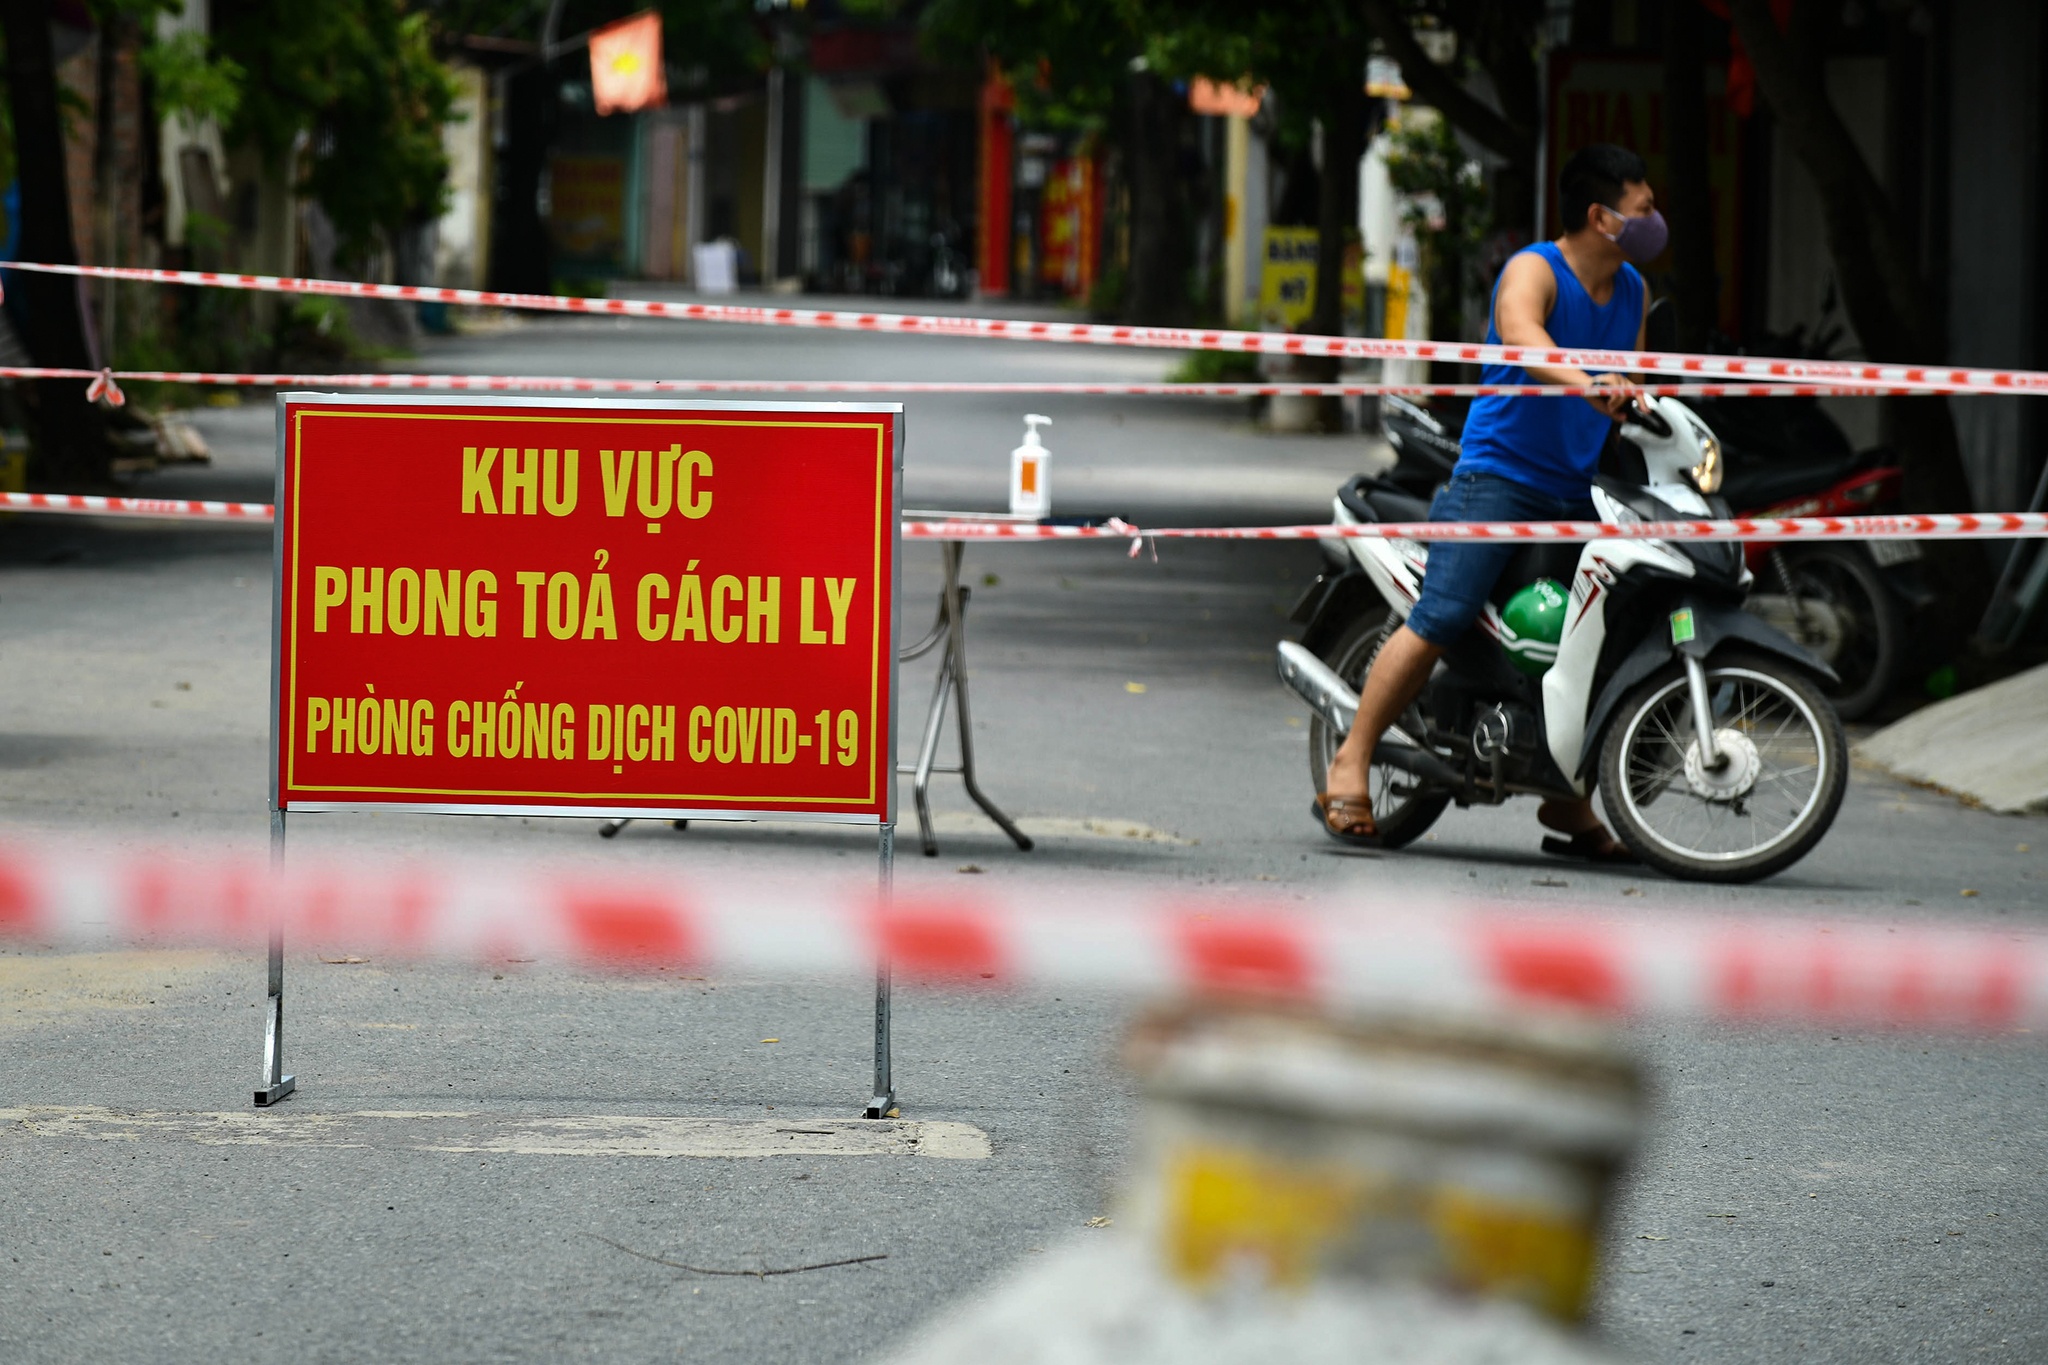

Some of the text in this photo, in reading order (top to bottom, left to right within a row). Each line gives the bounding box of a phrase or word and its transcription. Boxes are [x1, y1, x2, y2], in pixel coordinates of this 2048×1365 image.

[462, 444, 713, 533] KHU VỰC
[314, 549, 856, 644] PHONG TOẢ CÁCH LY
[307, 681, 858, 774] PHÒNG CHỐNG DỊCH COVID-19
